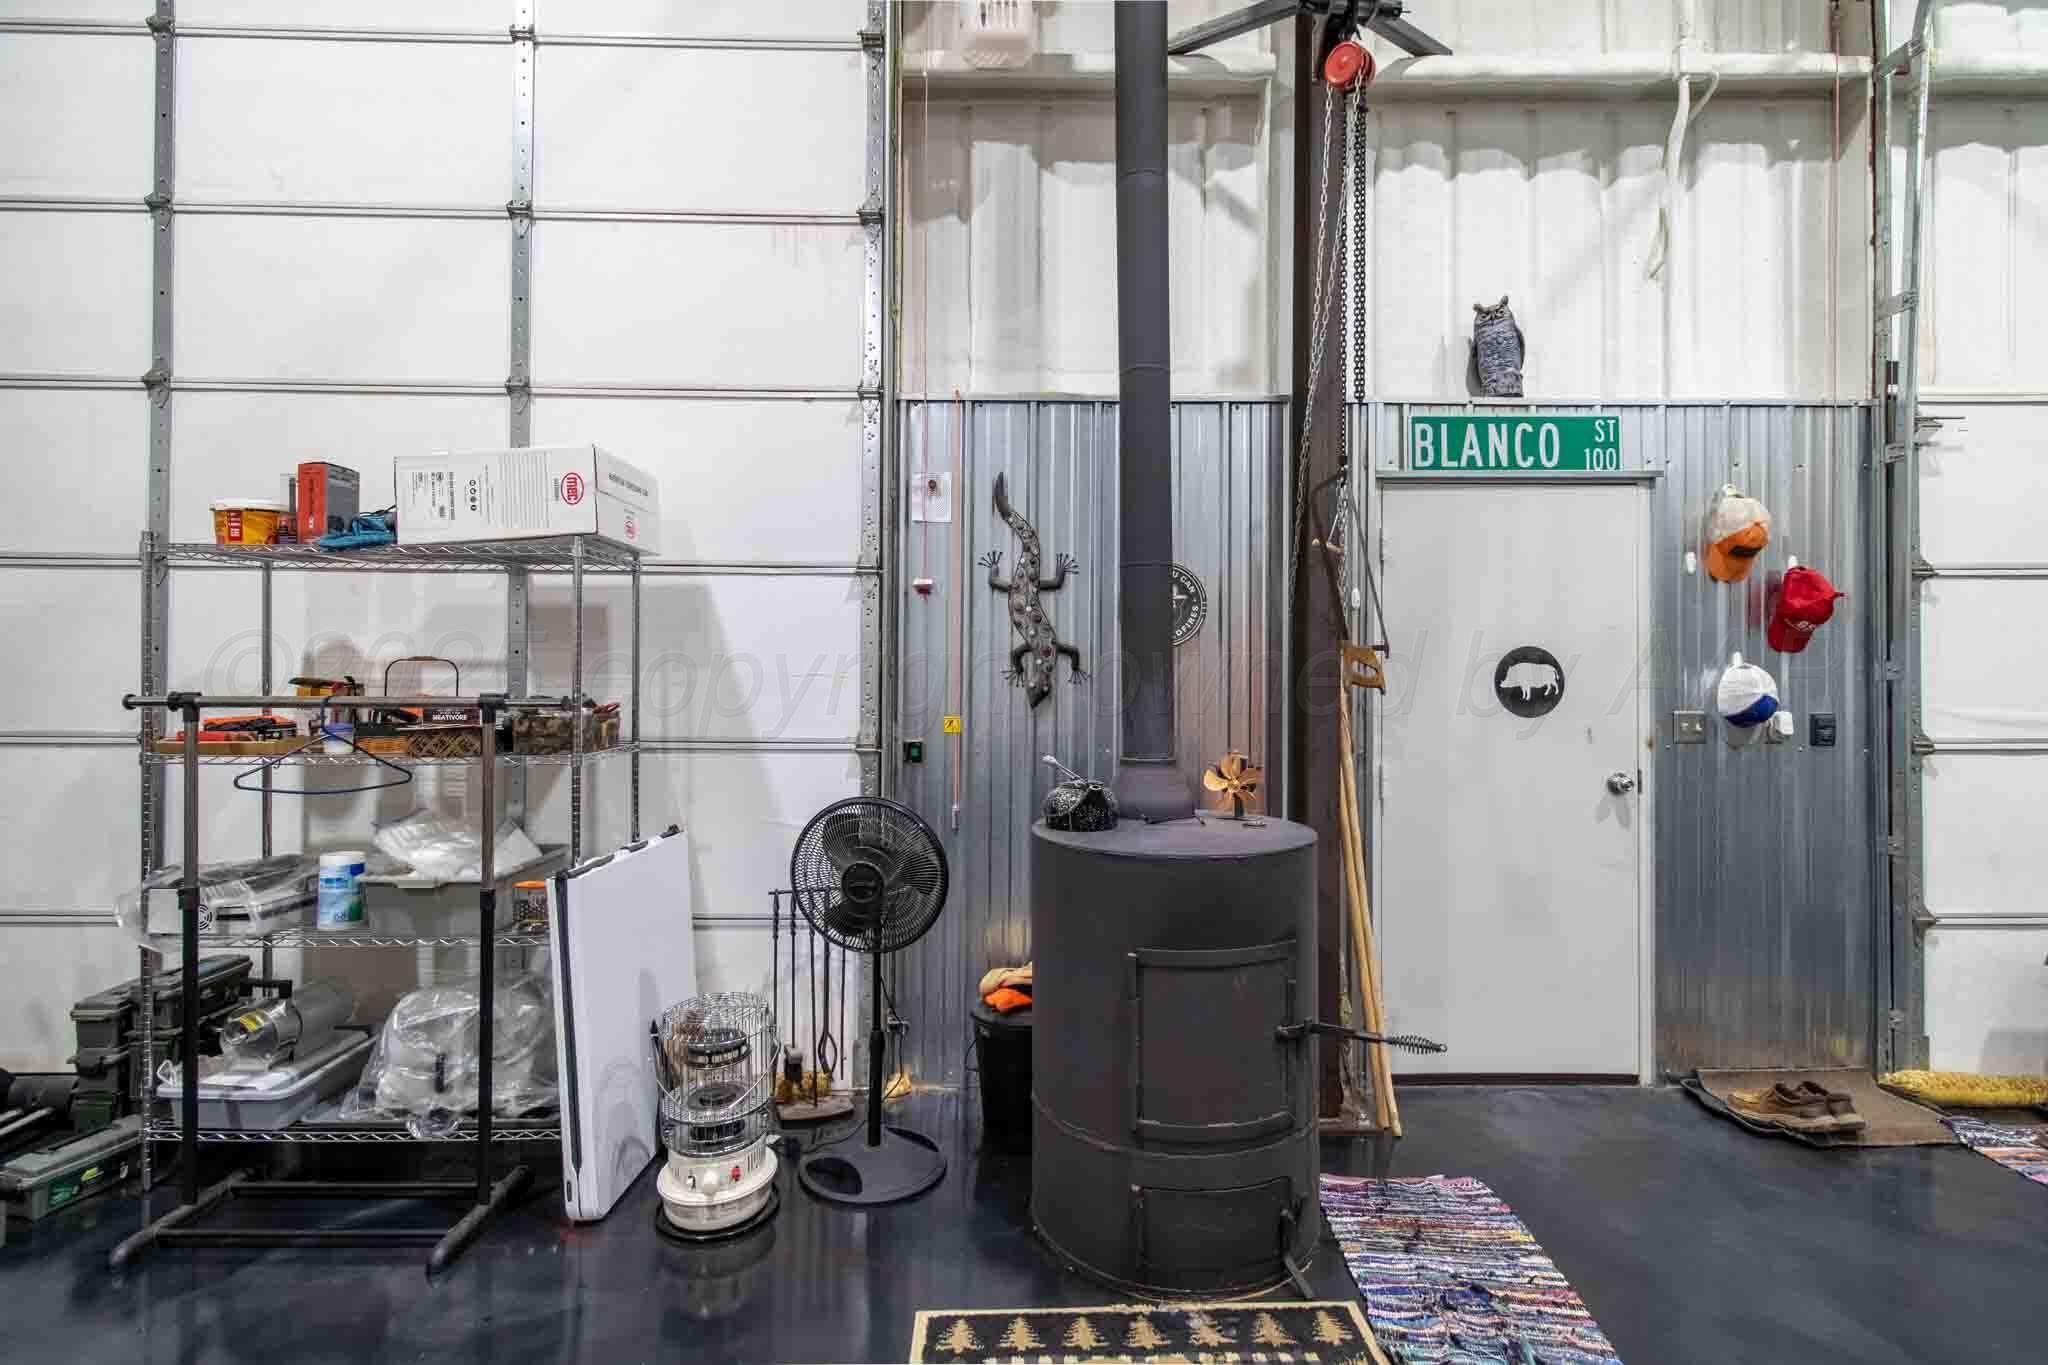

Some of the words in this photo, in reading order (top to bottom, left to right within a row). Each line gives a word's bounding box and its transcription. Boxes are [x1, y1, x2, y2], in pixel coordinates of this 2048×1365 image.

[1415, 423, 1560, 468] BLANCO
[1594, 419, 1616, 443] ST
[1584, 448, 1617, 471] 100
